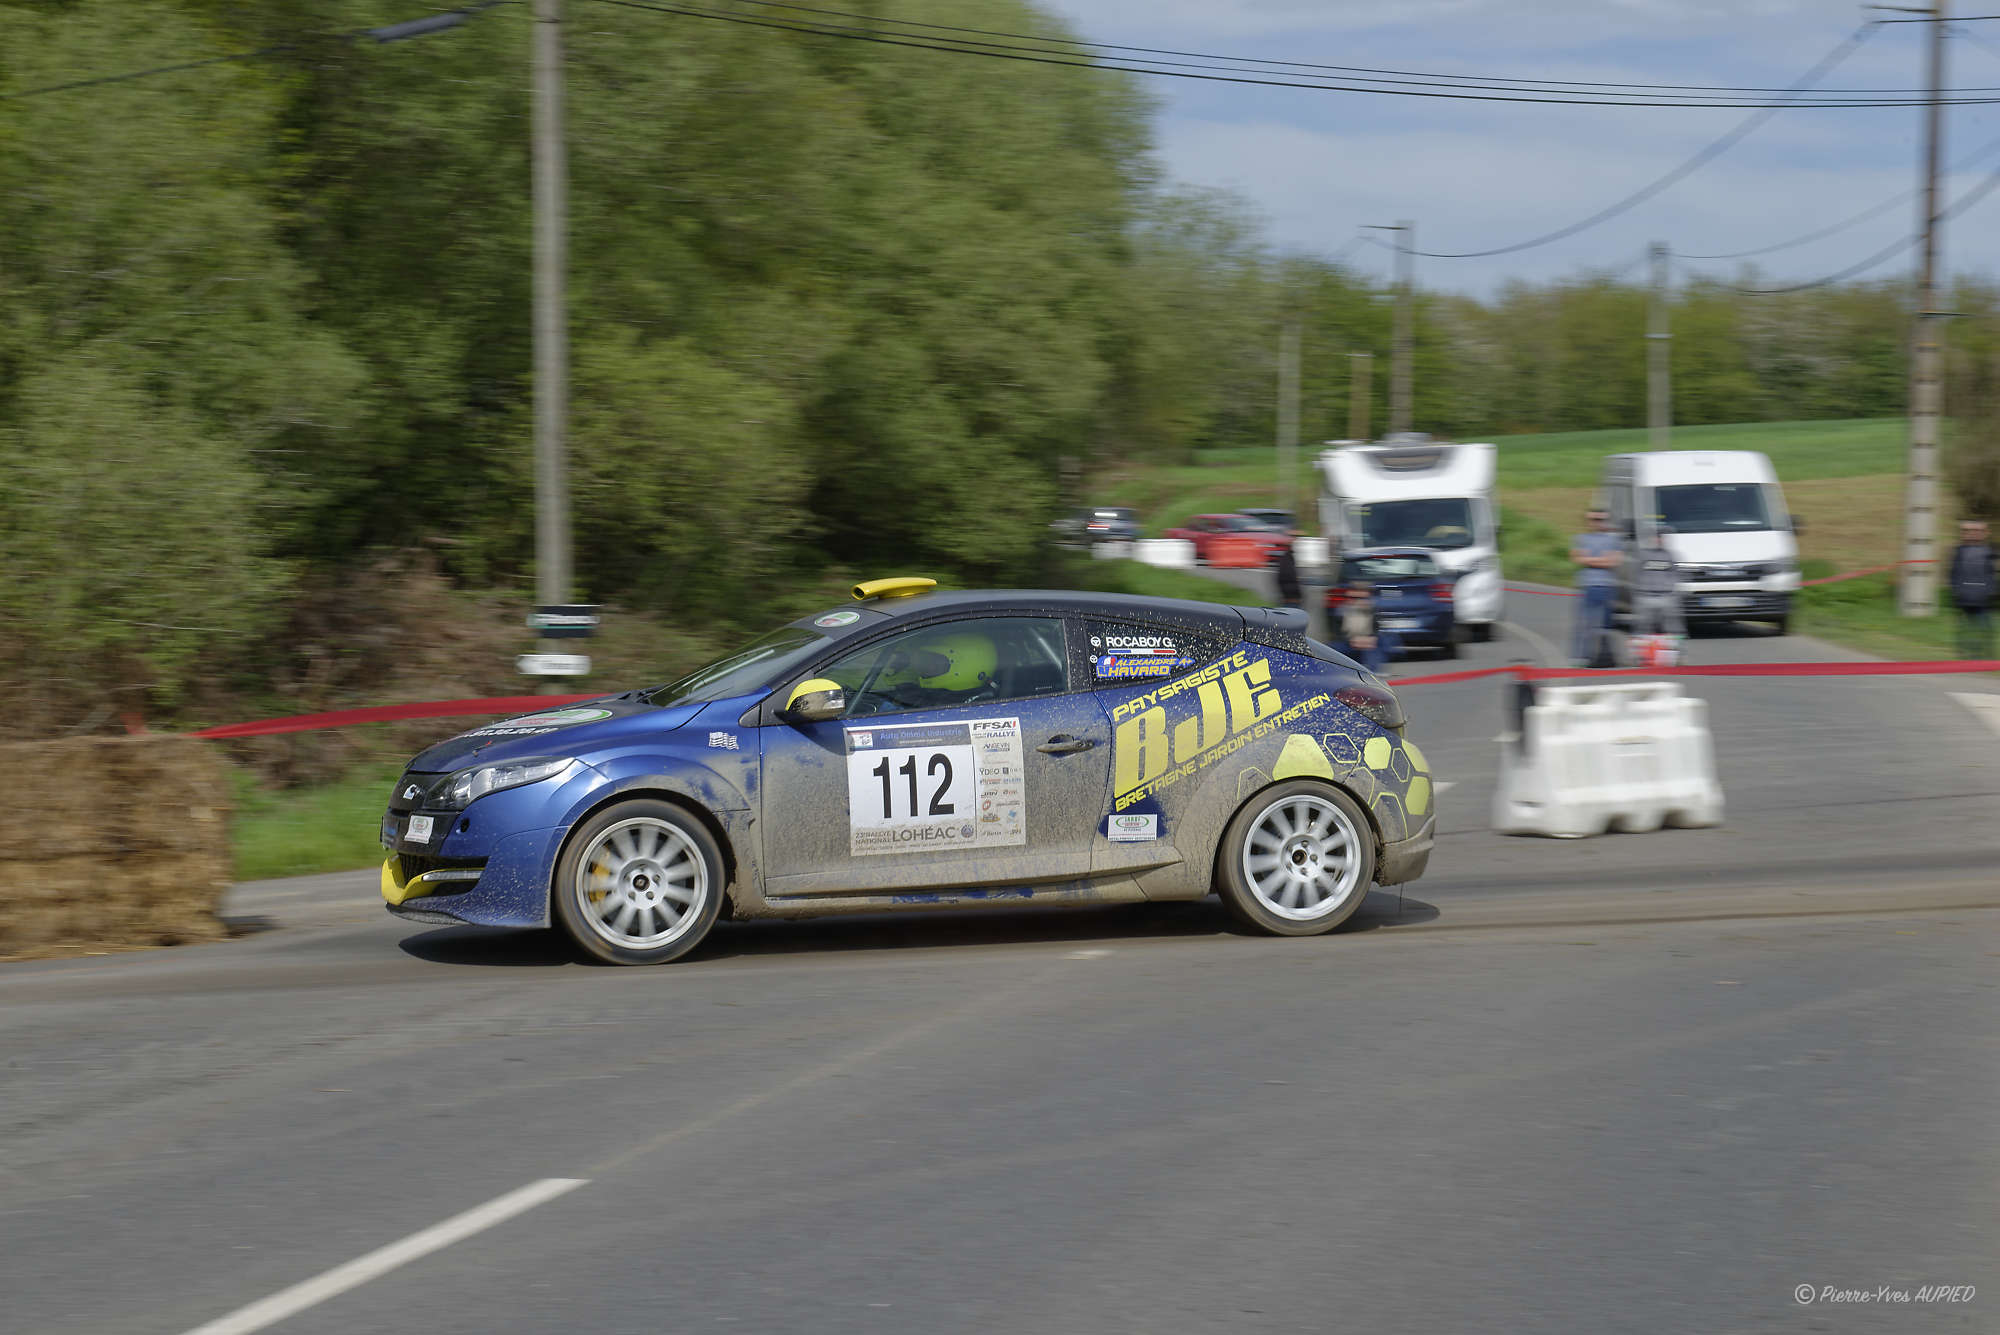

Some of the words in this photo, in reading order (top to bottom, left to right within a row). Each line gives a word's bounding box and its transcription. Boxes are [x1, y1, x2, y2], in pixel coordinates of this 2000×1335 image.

[1105, 636, 1161, 647] ROCABOY
[1162, 636, 1176, 647] G.
[1115, 657, 1177, 666] ALEXANDRE
[1108, 666, 1170, 676] HAVARD
[1112, 650, 1249, 722] PAYSAGISTE
[973, 721, 1012, 731] FFSA
[1116, 760, 1198, 813] BRETAGNE
[1199, 731, 1253, 768] JARDIN
[1254, 692, 1331, 739] ENTRETIEN
[872, 753, 955, 819] 112
[892, 826, 956, 842] LOHÉAC
[856, 837, 891, 846] NATIONAL
